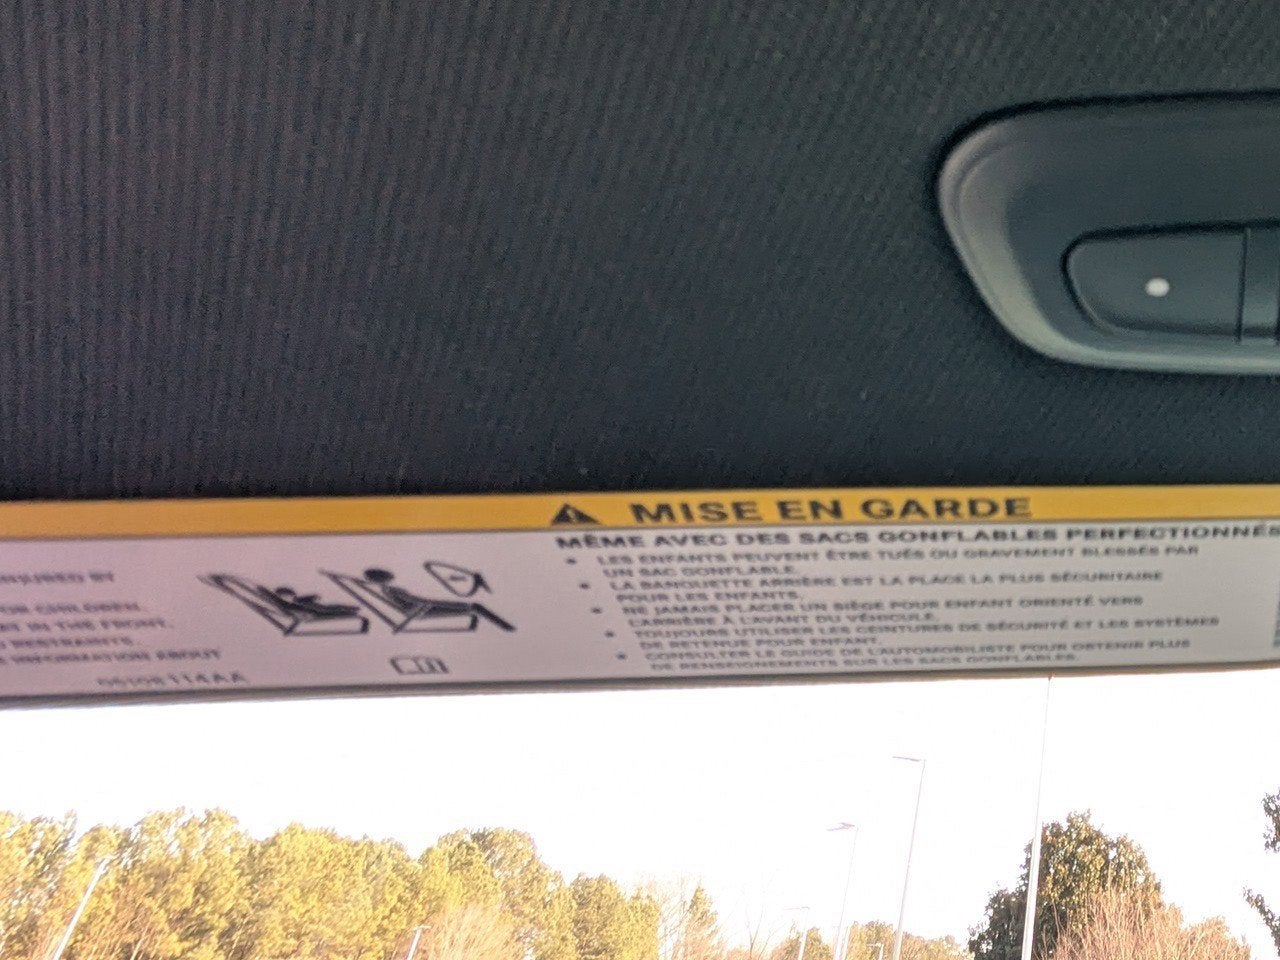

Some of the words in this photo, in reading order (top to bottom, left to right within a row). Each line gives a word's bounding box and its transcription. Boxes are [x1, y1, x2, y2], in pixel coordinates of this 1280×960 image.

[629, 501, 763, 524] MISE
[777, 500, 843, 521] EN
[861, 497, 1033, 520] GARDE
[556, 534, 646, 549] MÊME
[654, 533, 727, 547] AVEC
[736, 533, 791, 545] DES
[799, 531, 868, 544] SACS
[878, 528, 1057, 544] GONFLABLES
[638, 552, 727, 564] ENFANTS
[1164, 545, 1199, 555] PAR
